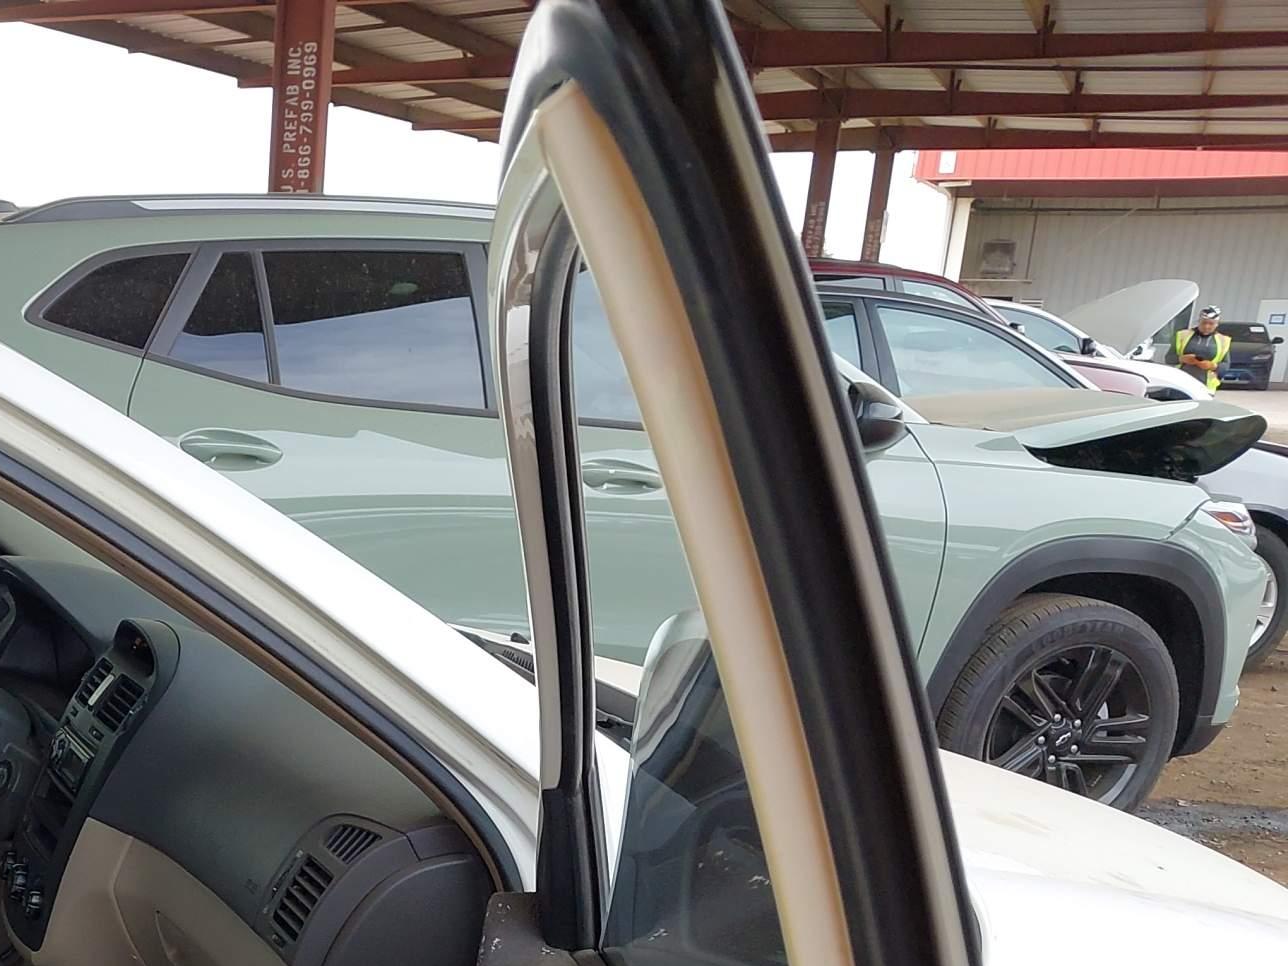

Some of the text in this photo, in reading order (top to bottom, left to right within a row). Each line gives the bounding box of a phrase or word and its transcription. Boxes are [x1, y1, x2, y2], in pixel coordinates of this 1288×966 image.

[286, 41, 303, 76] INC.
[282, 84, 300, 153] PREFAB
[295, 41, 318, 193] 1-866-799-0969
